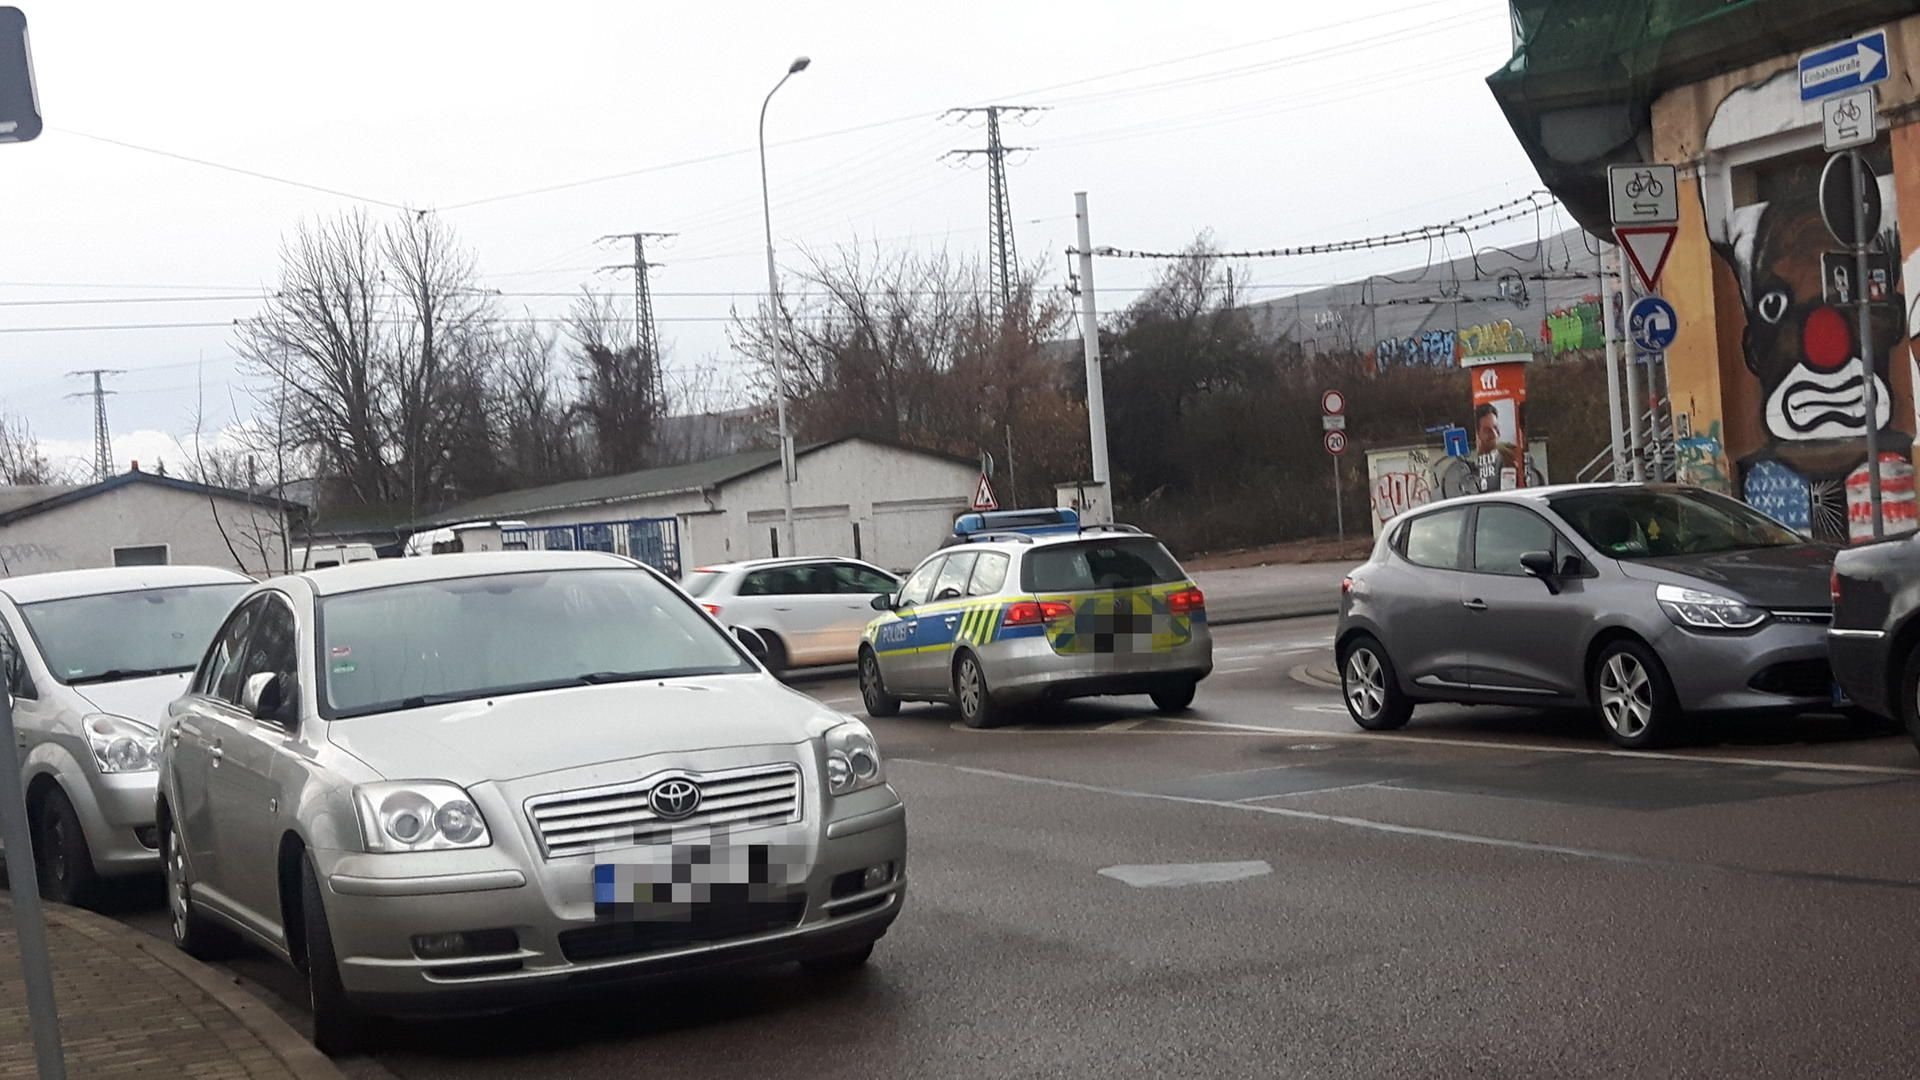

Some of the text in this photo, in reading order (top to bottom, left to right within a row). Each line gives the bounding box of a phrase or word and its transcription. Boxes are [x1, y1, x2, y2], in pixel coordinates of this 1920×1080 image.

[1804, 58, 1860, 84] Einbahnstraße
[1330, 436, 1342, 449] 20
[882, 623, 907, 643] POLIZEI
